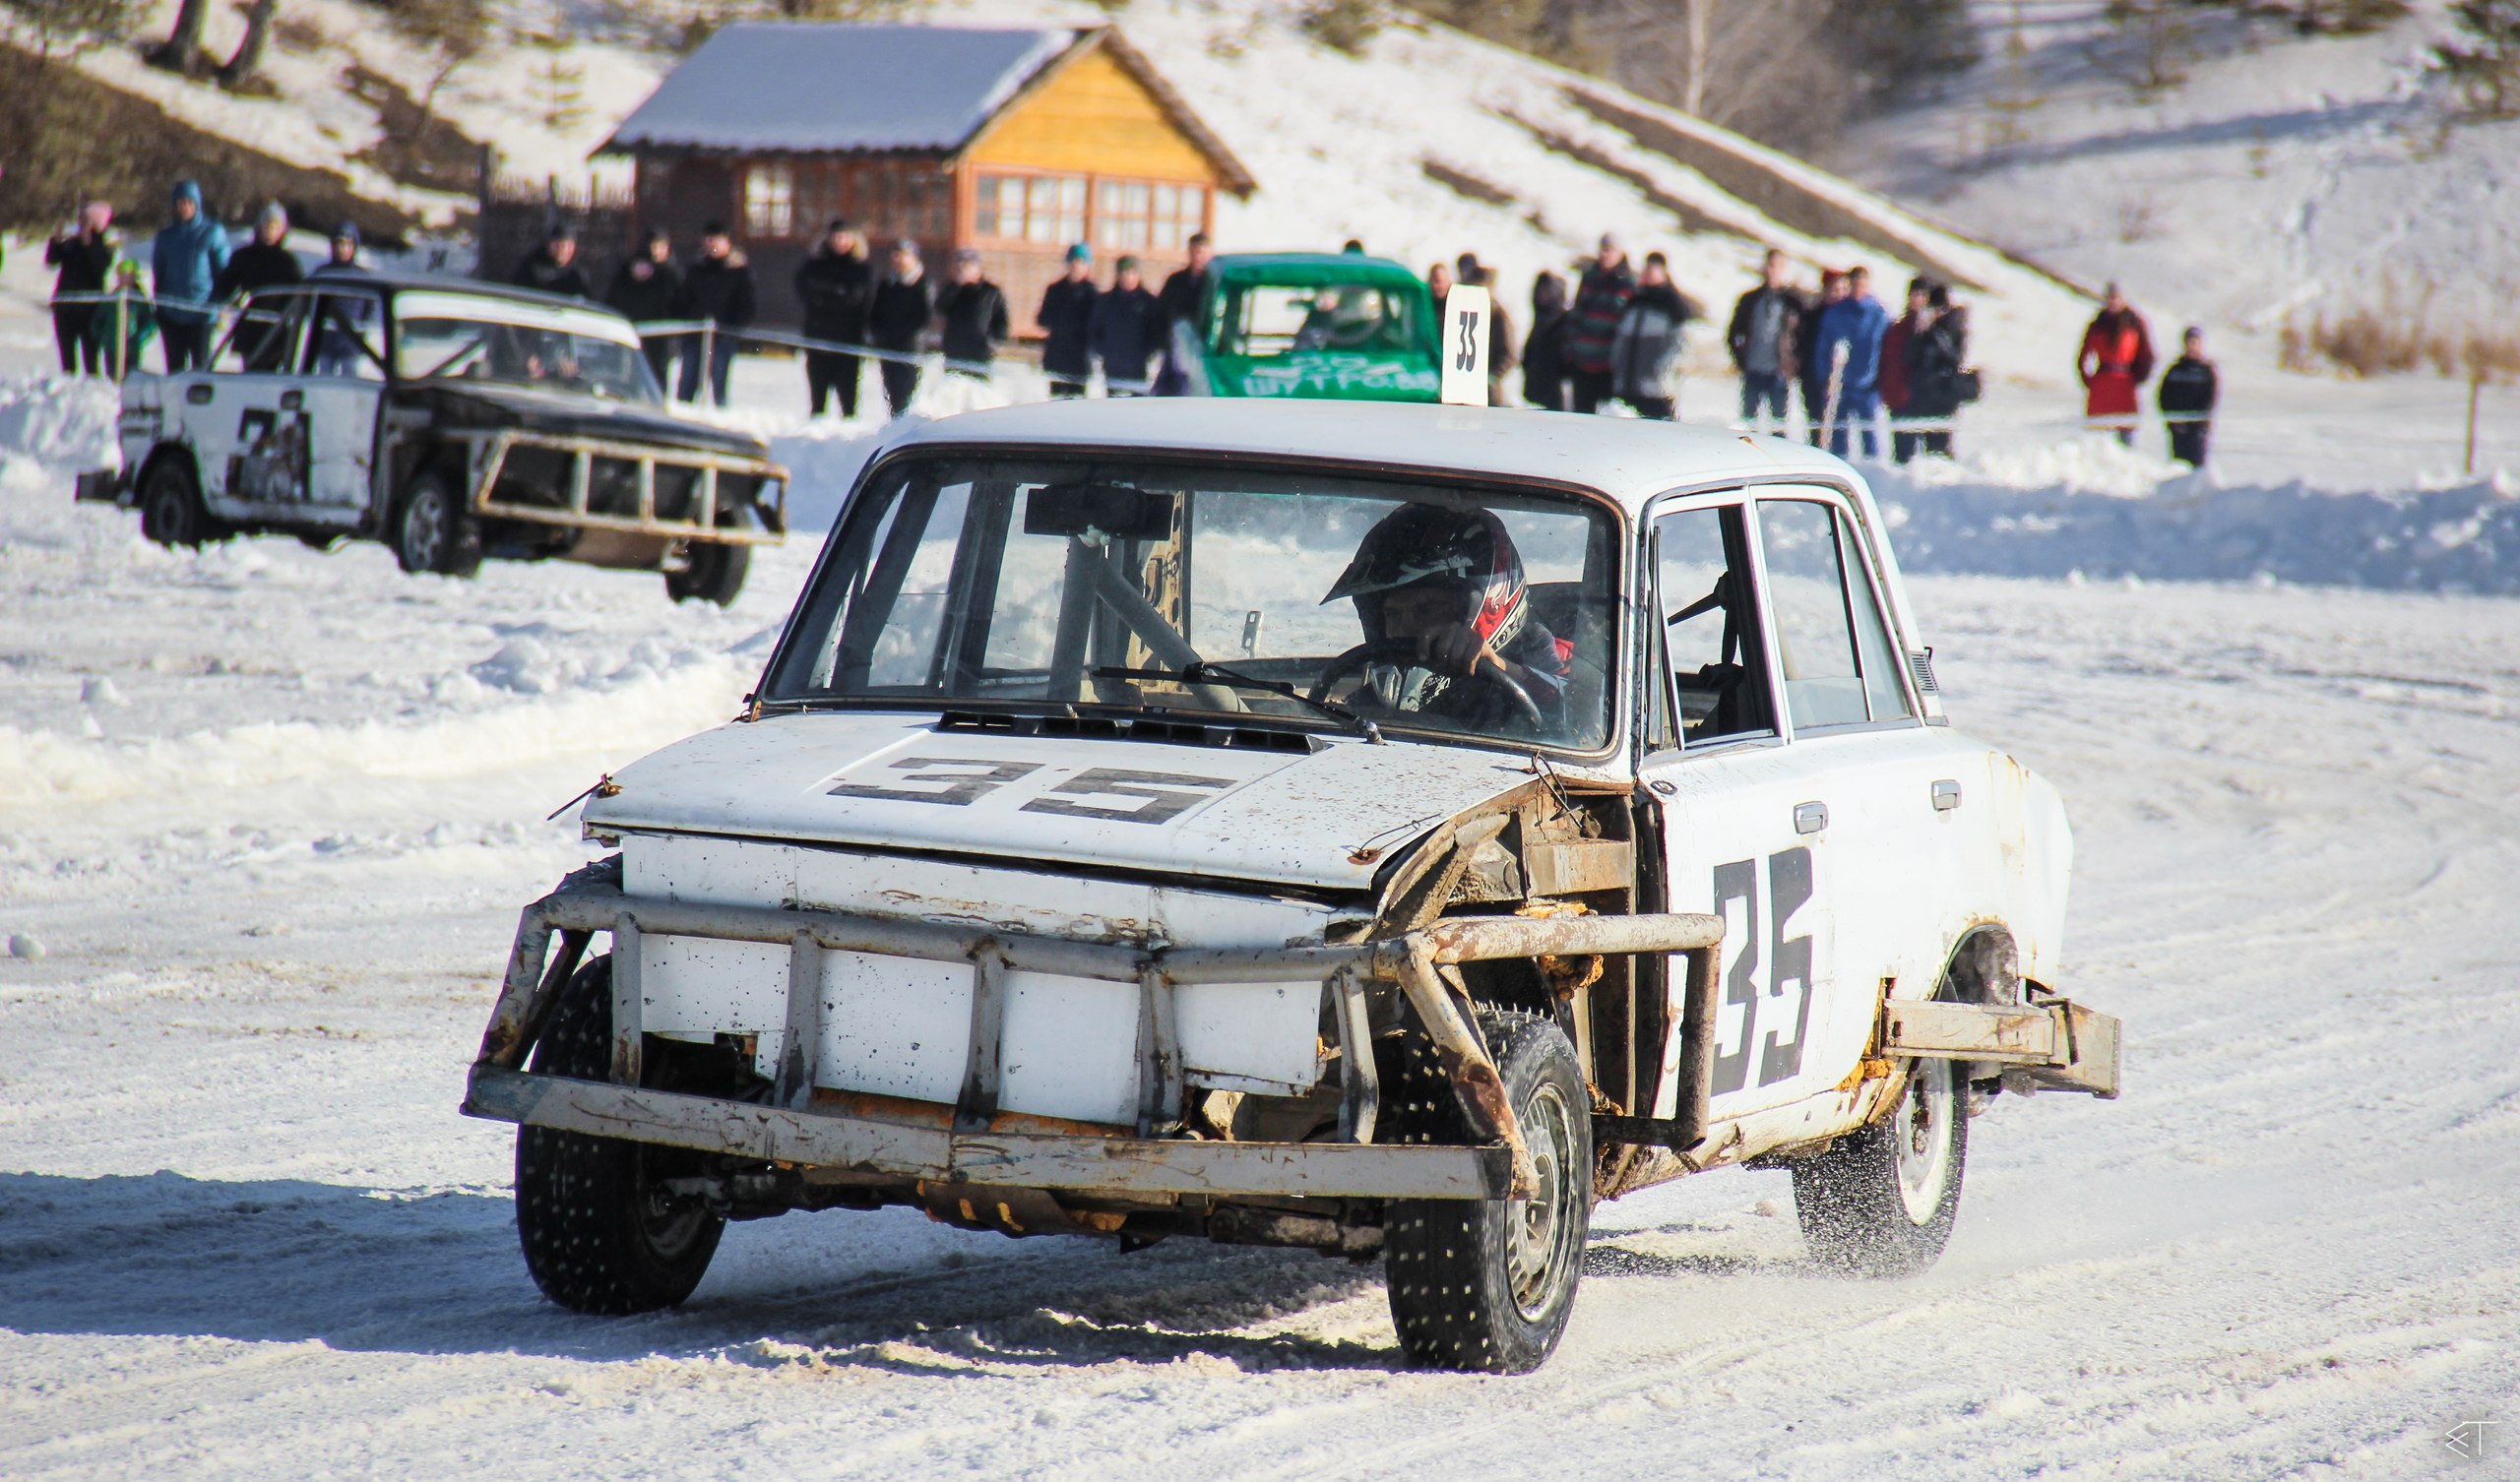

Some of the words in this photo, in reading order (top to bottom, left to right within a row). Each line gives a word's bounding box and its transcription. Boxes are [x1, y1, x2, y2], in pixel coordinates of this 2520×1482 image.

[1456, 310, 1479, 372] 35
[827, 757, 1238, 825] 35
[1711, 847, 1813, 1096] 35
